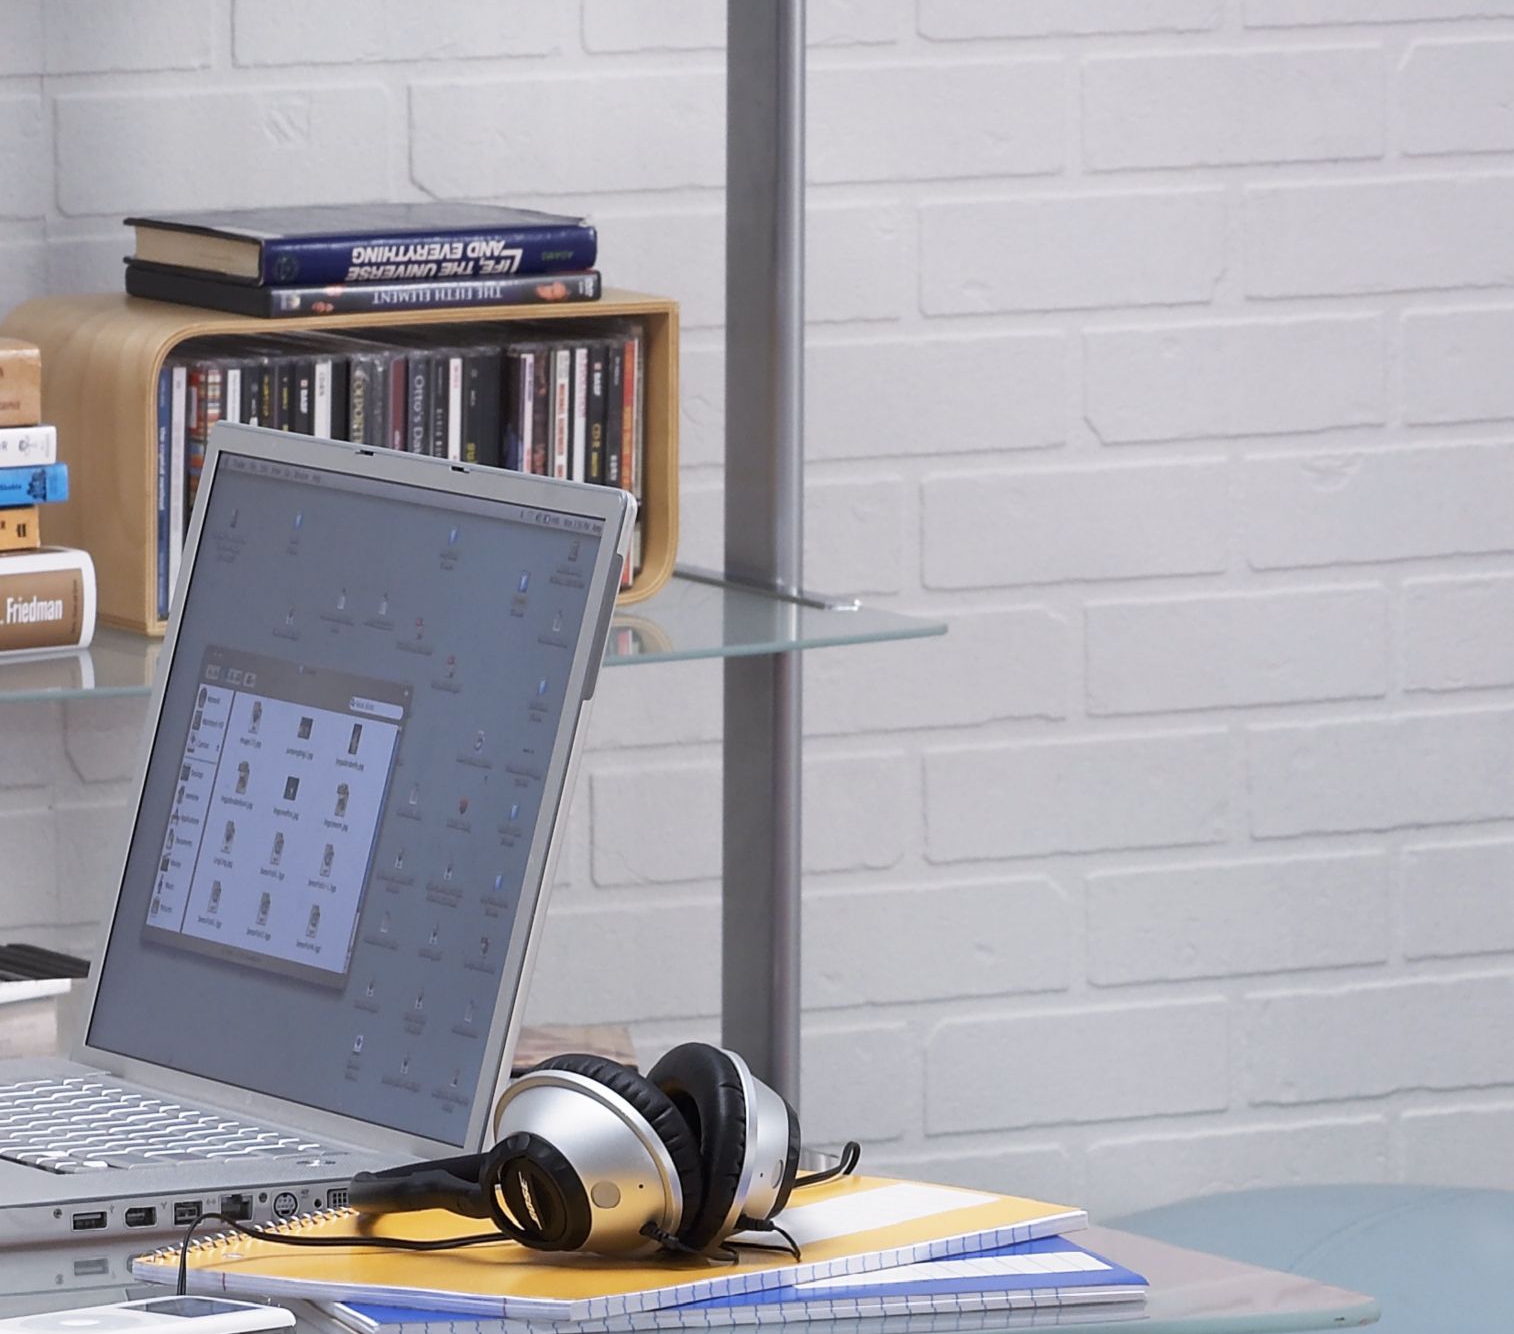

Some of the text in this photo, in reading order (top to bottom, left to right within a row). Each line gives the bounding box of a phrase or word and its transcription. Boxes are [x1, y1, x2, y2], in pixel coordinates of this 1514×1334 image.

[351, 239, 506, 264] AND EVERYTHING
[345, 263, 438, 282] UNIVERSE
[440, 260, 475, 277] THE
[371, 285, 502, 305] THE FIFTH ELEMENT
[412, 375, 426, 423] Otto's
[7, 596, 63, 624] Friedman
